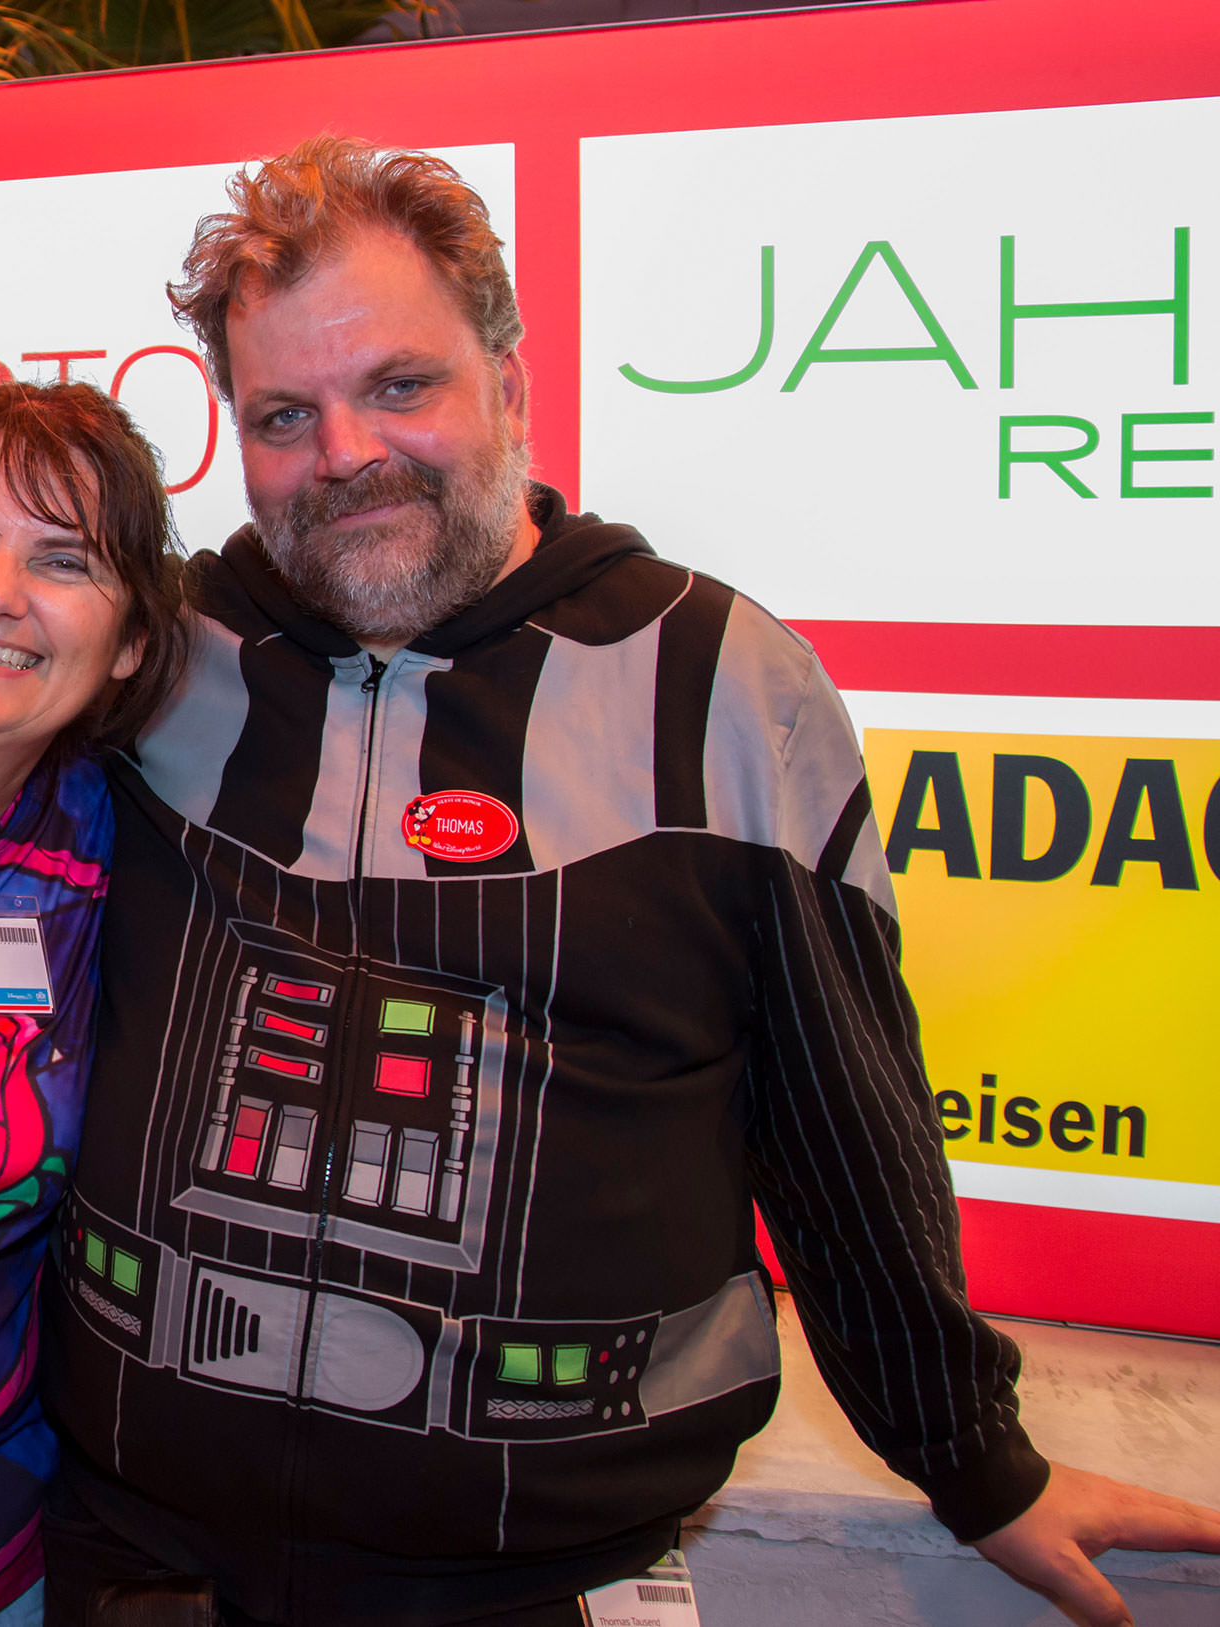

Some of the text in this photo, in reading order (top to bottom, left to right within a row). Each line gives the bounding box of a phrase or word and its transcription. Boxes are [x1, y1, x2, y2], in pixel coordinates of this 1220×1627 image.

[618, 226, 1190, 395] JAH
[998, 411, 1215, 499] RE
[435, 817, 484, 836] THOMAS
[884, 750, 1220, 891] ADA
[598, 1616, 661, 1627] Thomas Tausend
